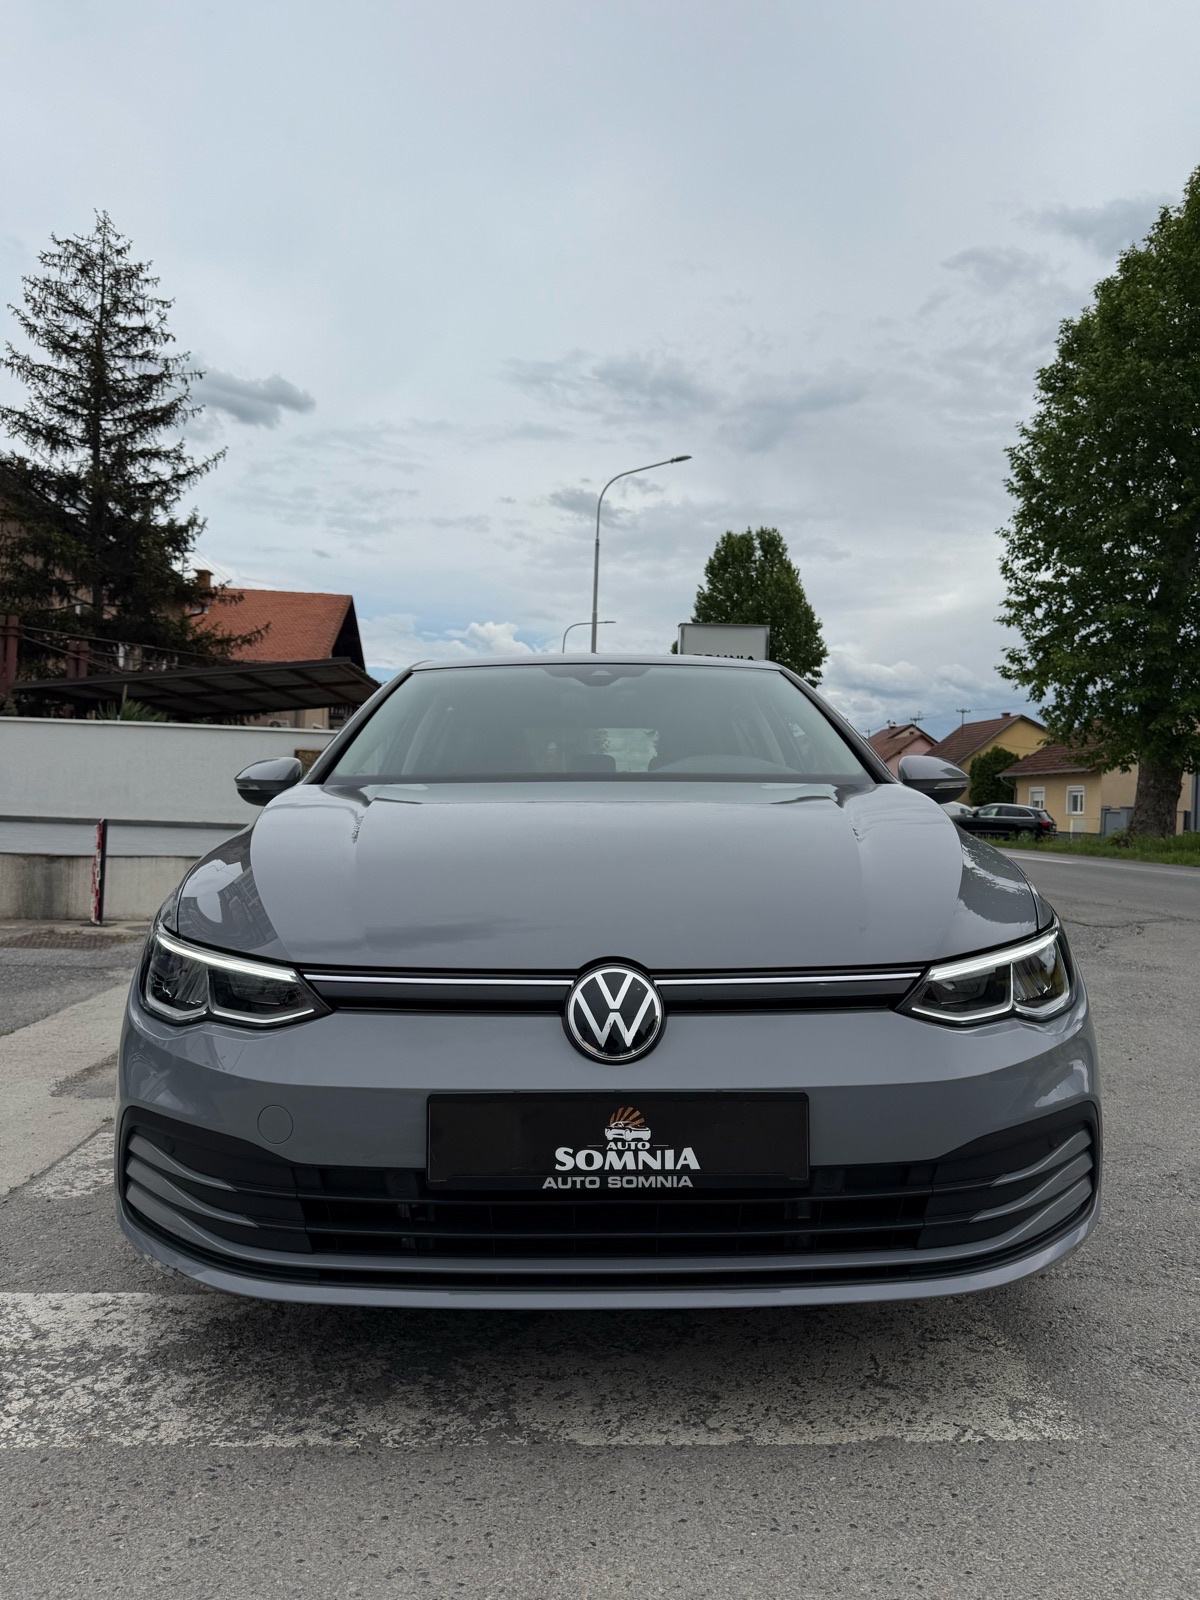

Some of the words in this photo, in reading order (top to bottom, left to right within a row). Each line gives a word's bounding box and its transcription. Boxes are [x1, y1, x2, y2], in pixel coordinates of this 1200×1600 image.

[606, 1141, 650, 1150] AUTO
[555, 1147, 701, 1171] SOMNIA
[542, 1176, 600, 1189] AUTO
[607, 1175, 694, 1188] SOMNIA
